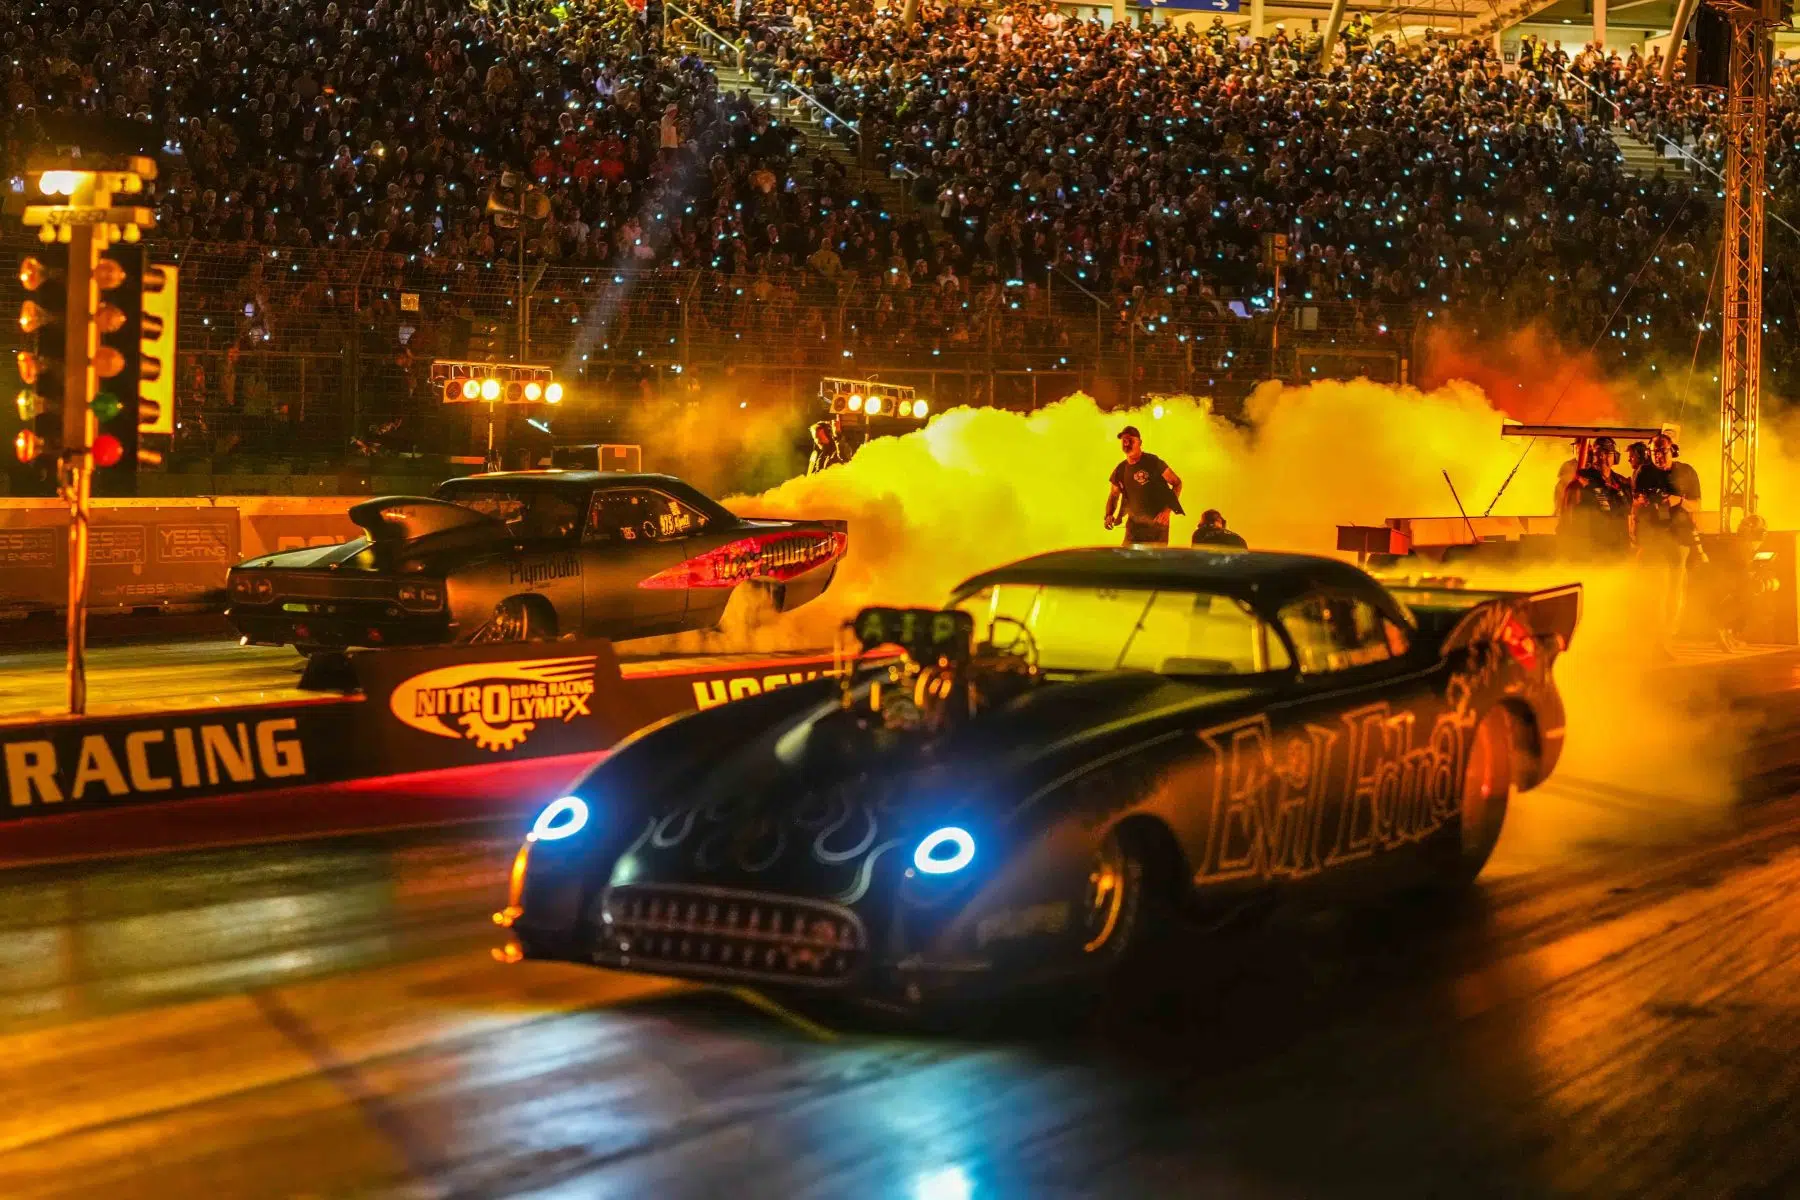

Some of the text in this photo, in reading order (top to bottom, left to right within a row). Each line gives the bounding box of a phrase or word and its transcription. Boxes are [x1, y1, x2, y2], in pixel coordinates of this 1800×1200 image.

[508, 552, 581, 588] Plymouth
[416, 684, 511, 724] NITRO
[511, 679, 595, 700] DRAG RACING
[4, 718, 306, 807] RACING
